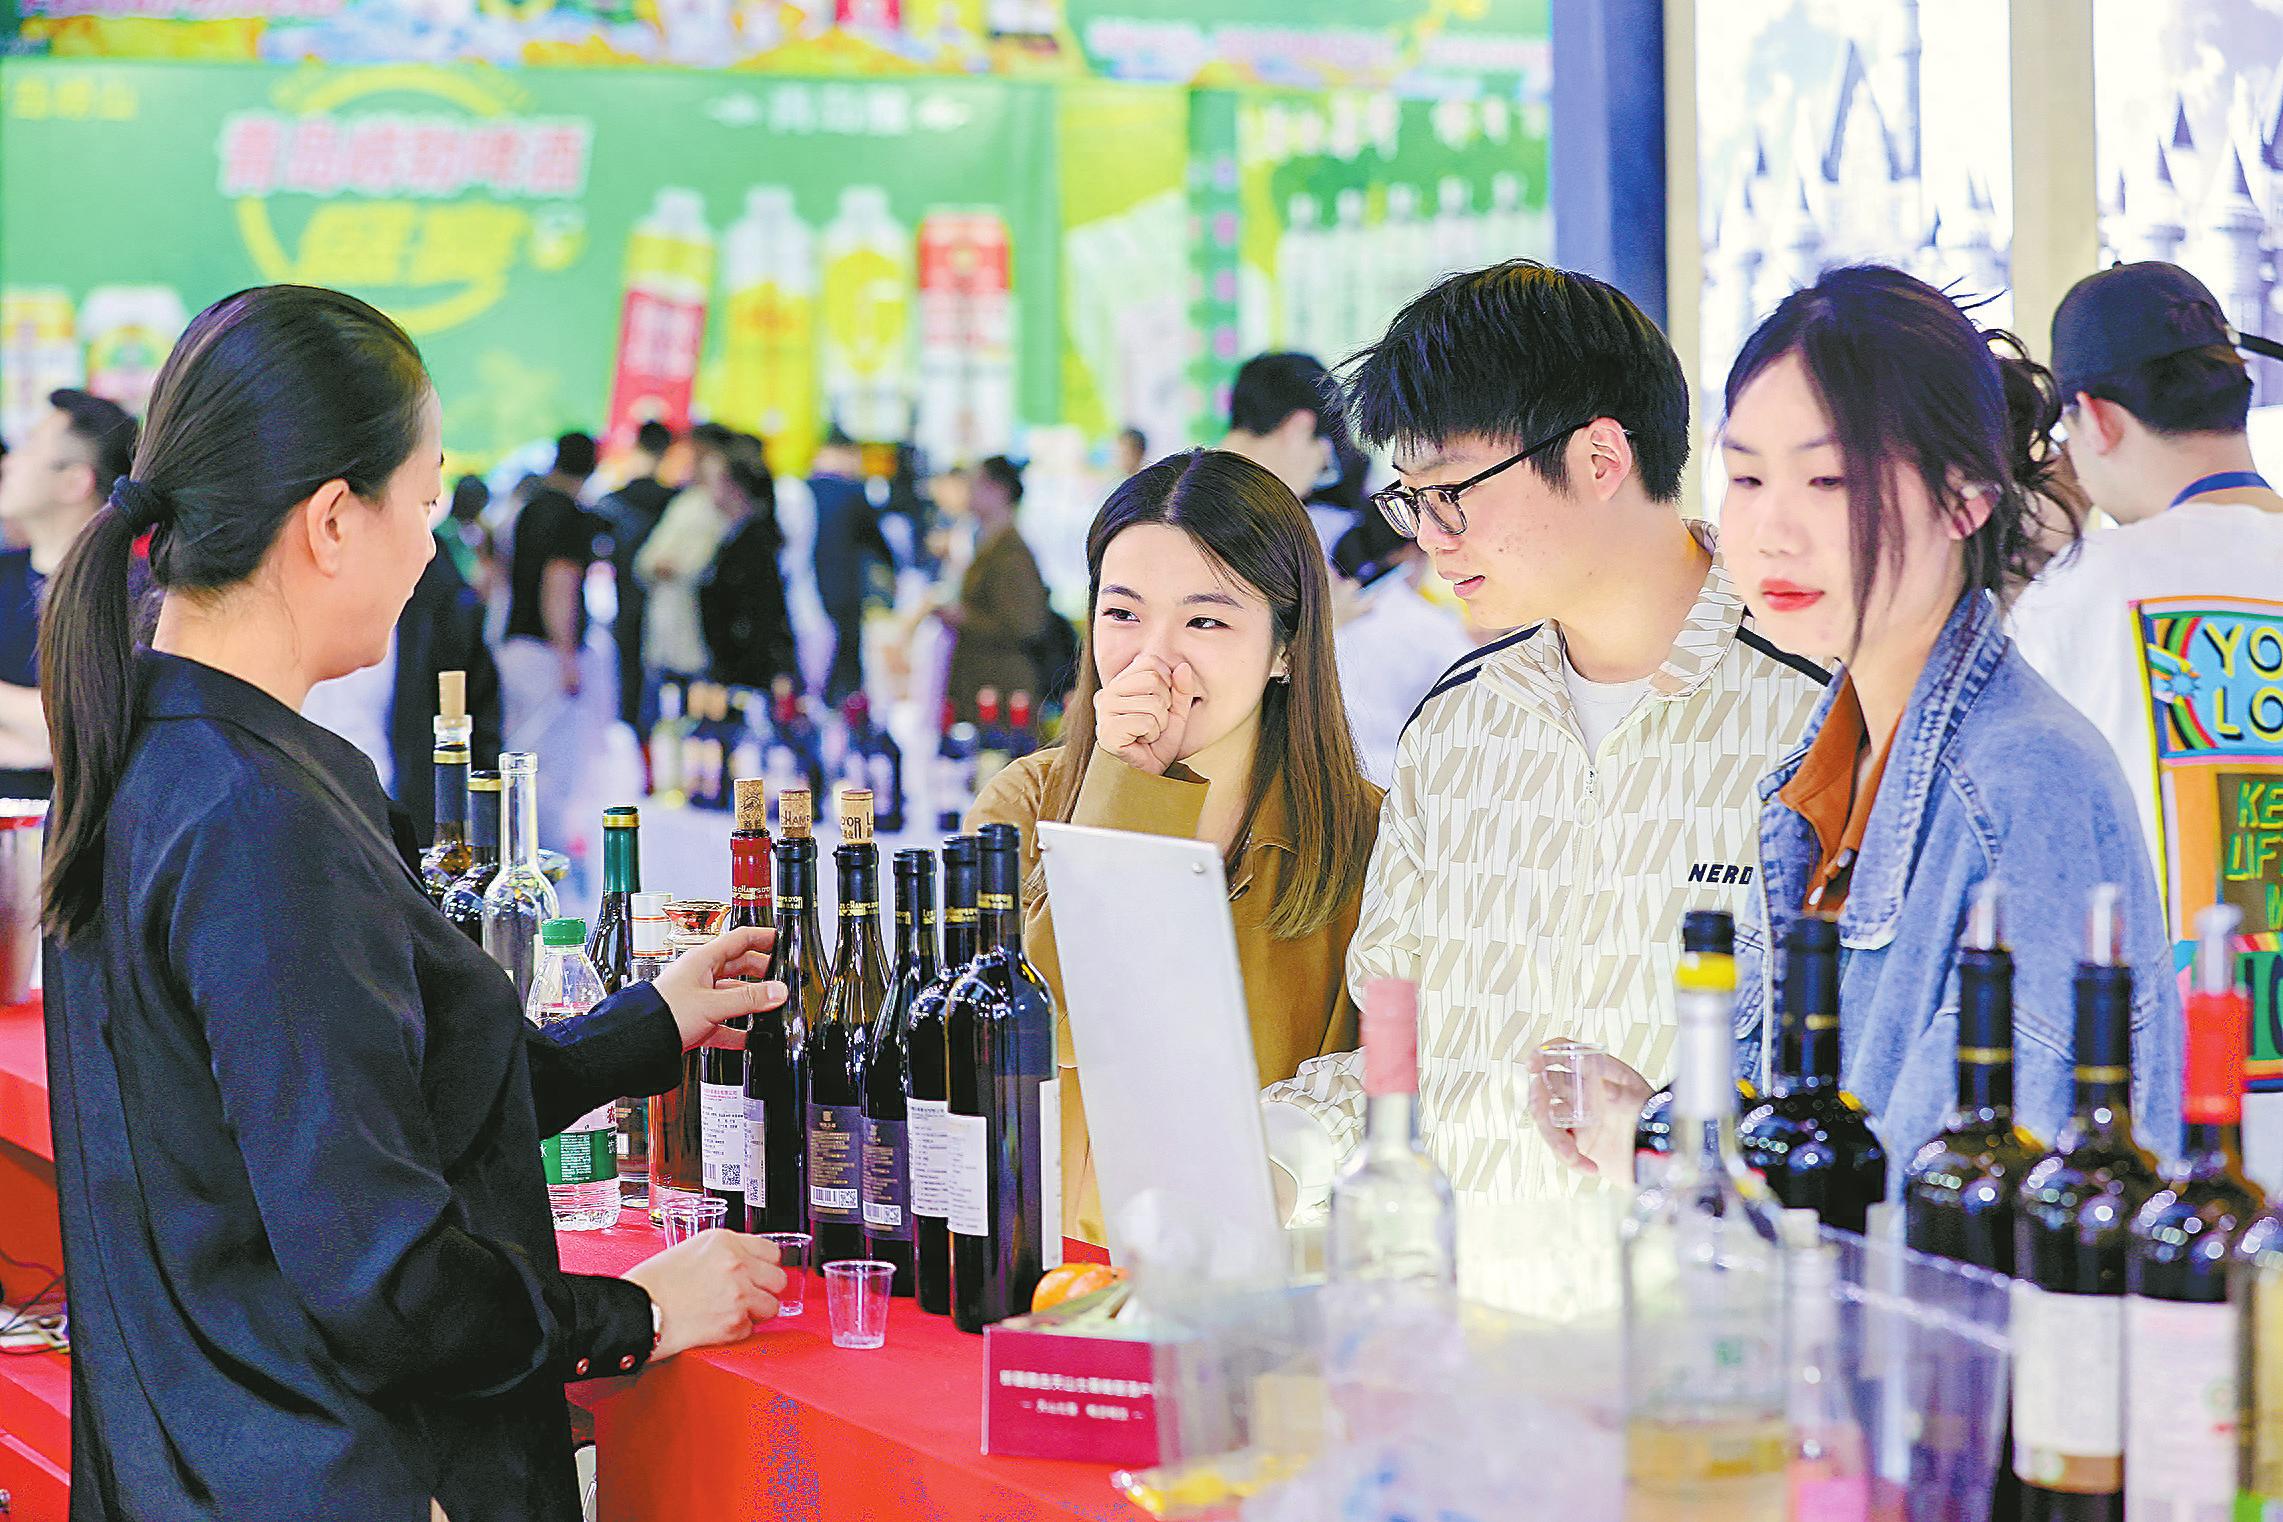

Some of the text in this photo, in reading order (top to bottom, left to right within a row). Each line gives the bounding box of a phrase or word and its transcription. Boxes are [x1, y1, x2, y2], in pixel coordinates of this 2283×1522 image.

[2203, 623, 2283, 680] YO
[2214, 685, 2283, 742] LO
[1688, 863, 1754, 885] NERD
[2224, 833, 2283, 880] LIF
